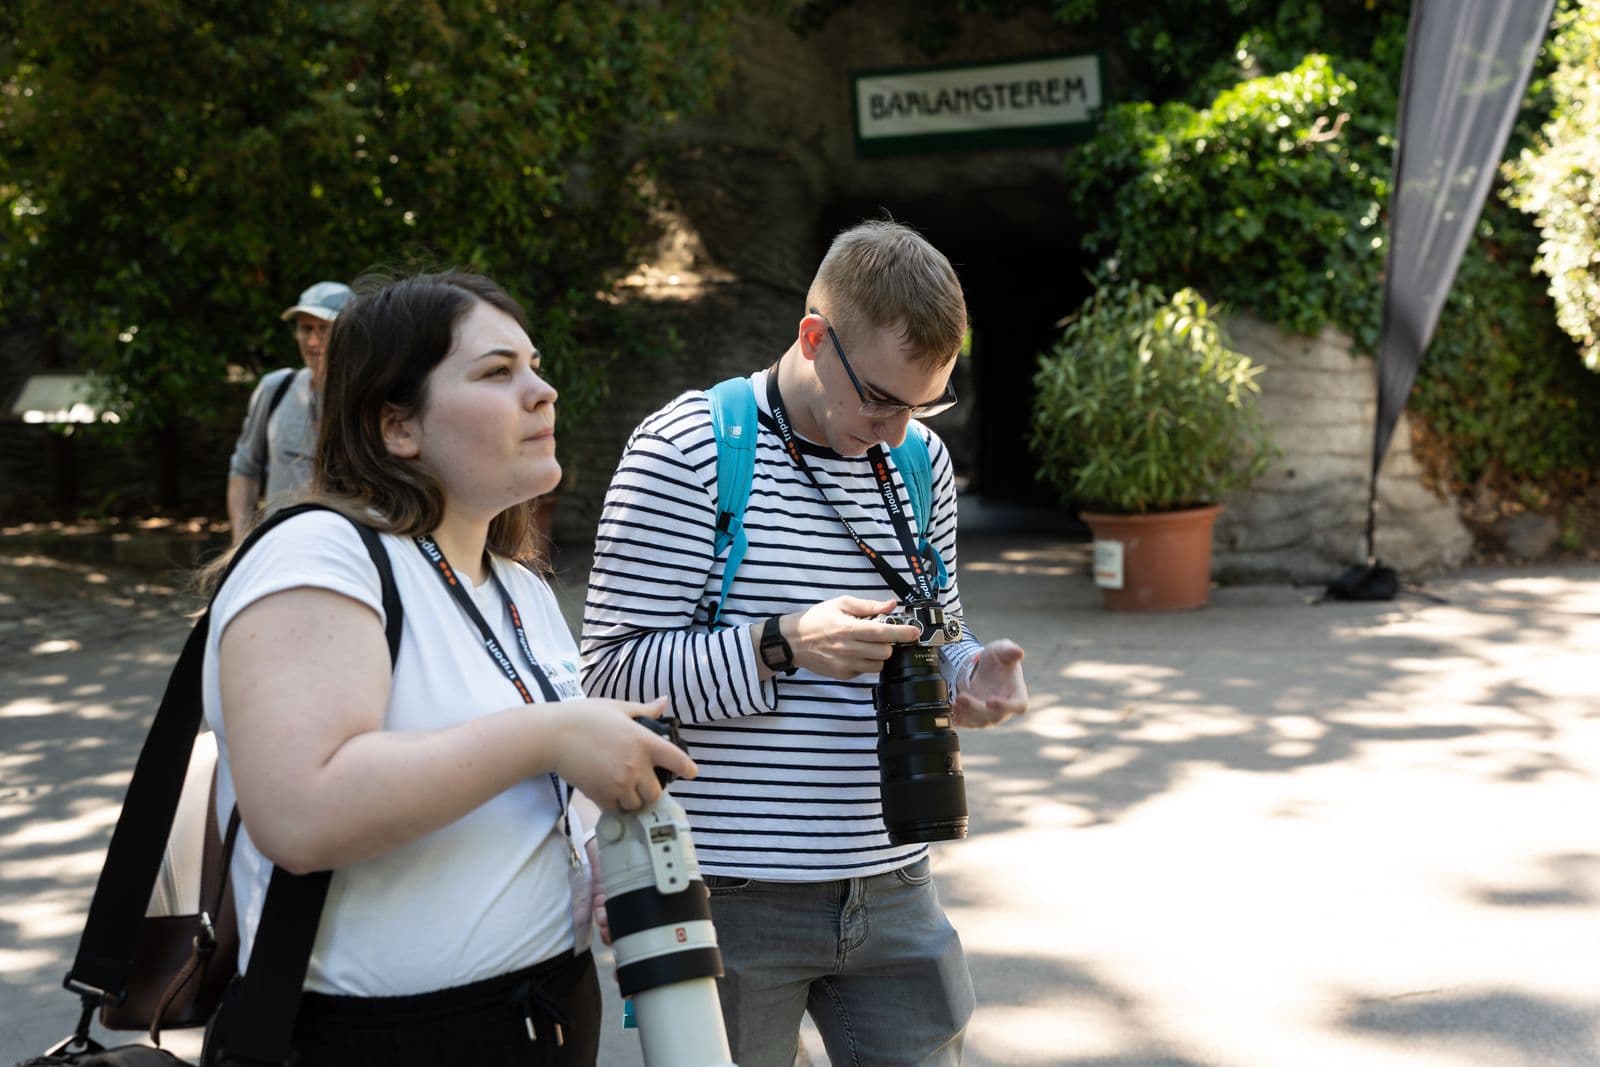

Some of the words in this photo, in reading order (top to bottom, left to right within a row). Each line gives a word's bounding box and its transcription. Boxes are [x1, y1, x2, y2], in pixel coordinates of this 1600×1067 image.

[869, 76, 1088, 121] BARLANGTEREM
[773, 407, 791, 442] tripont
[882, 482, 900, 514] tripont
[486, 639, 517, 680] tripont
